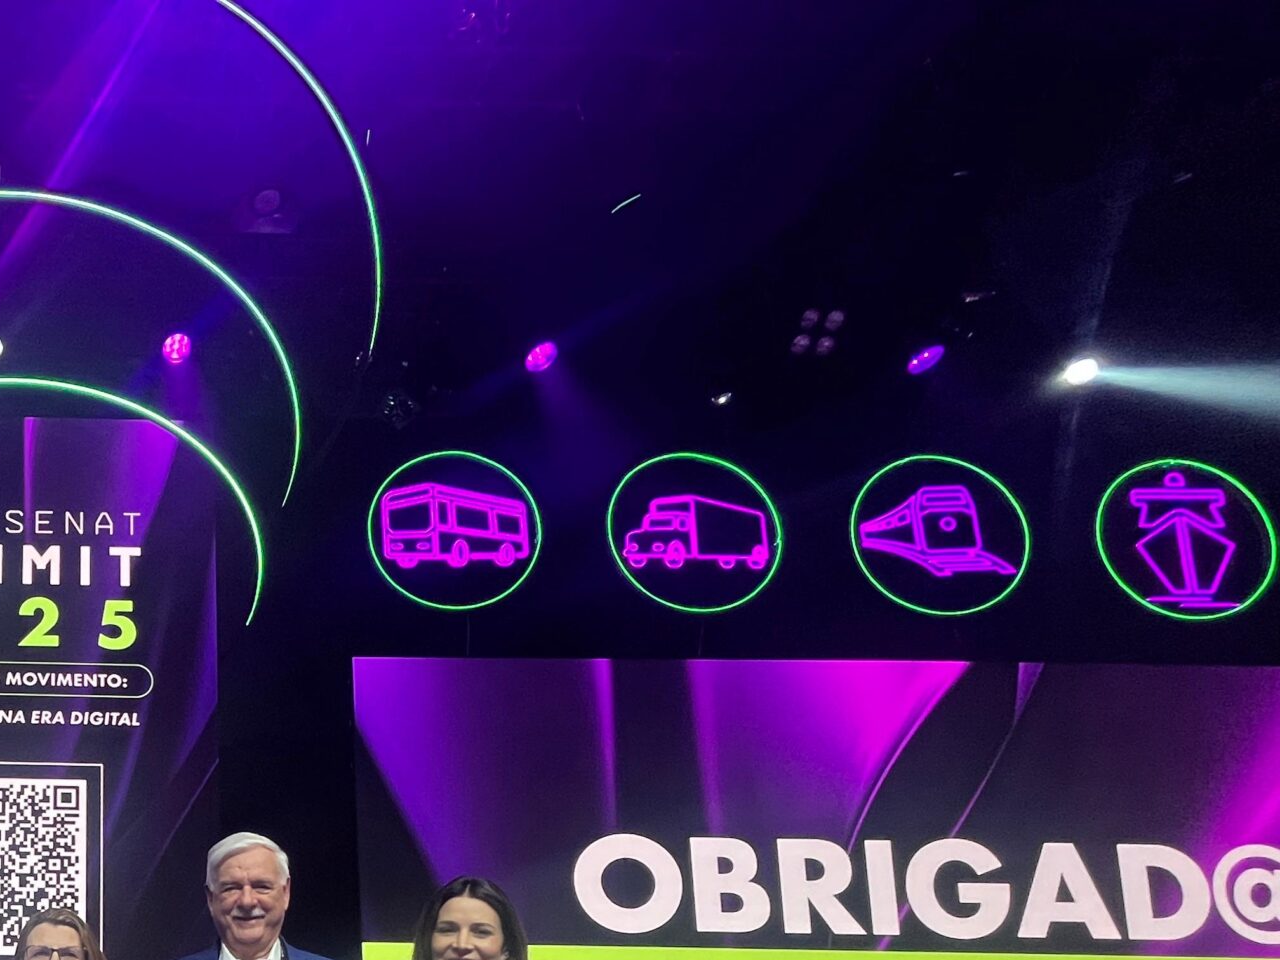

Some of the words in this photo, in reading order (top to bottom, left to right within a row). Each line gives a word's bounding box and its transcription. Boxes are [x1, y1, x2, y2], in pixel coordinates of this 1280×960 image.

[5, 509, 141, 536] SENAT
[5, 672, 129, 689] MOVIMENTO:
[30, 710, 64, 726] ERA
[70, 711, 141, 727] DIGITAL
[573, 833, 1280, 945] OBRIGAD@
